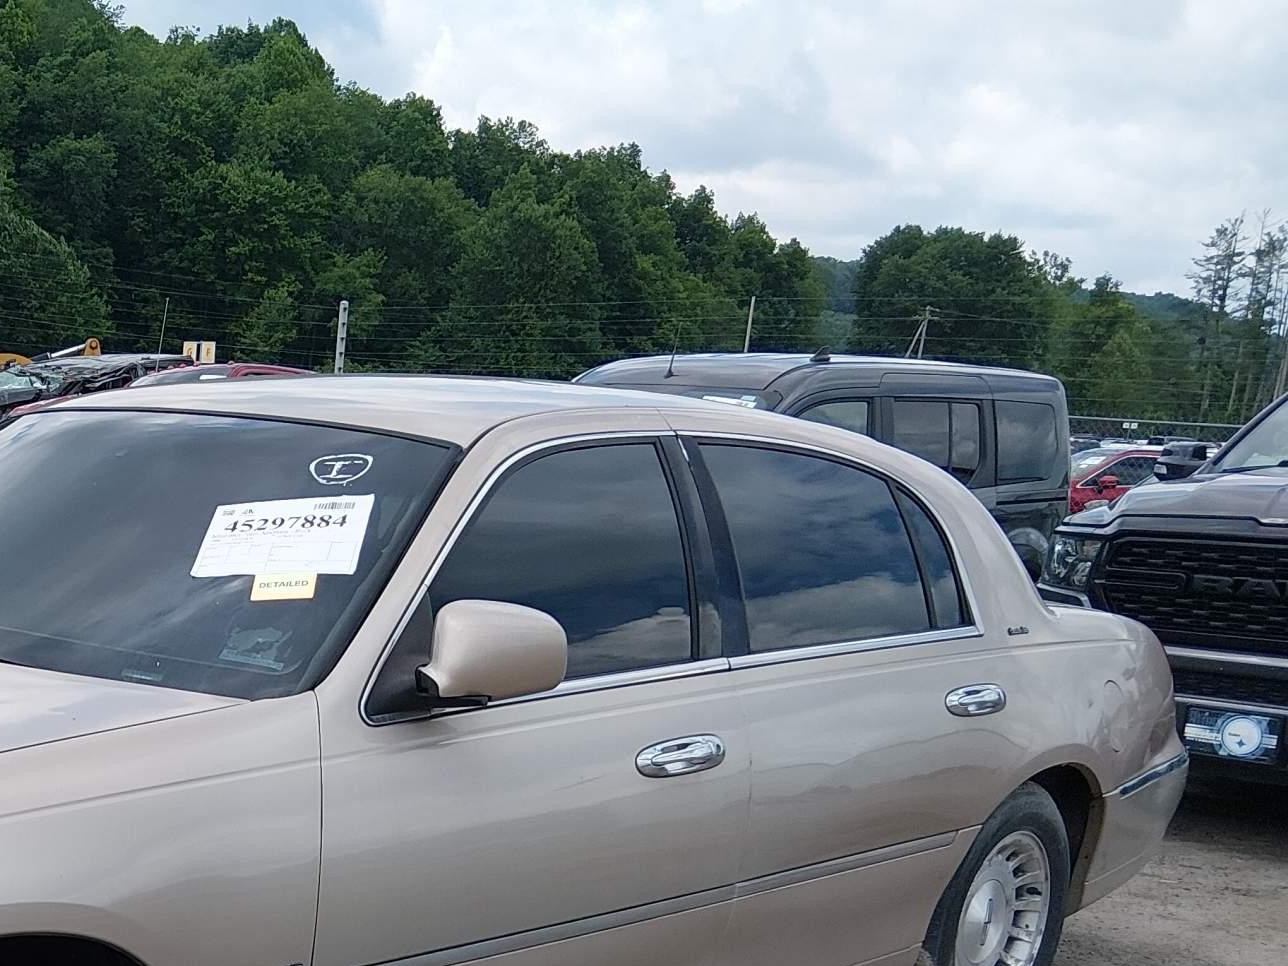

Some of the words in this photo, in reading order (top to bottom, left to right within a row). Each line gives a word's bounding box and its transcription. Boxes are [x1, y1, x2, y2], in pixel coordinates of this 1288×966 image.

[224, 514, 348, 533] 45297884
[259, 580, 309, 589] DETAILED
[1193, 574, 1288, 600] RA
